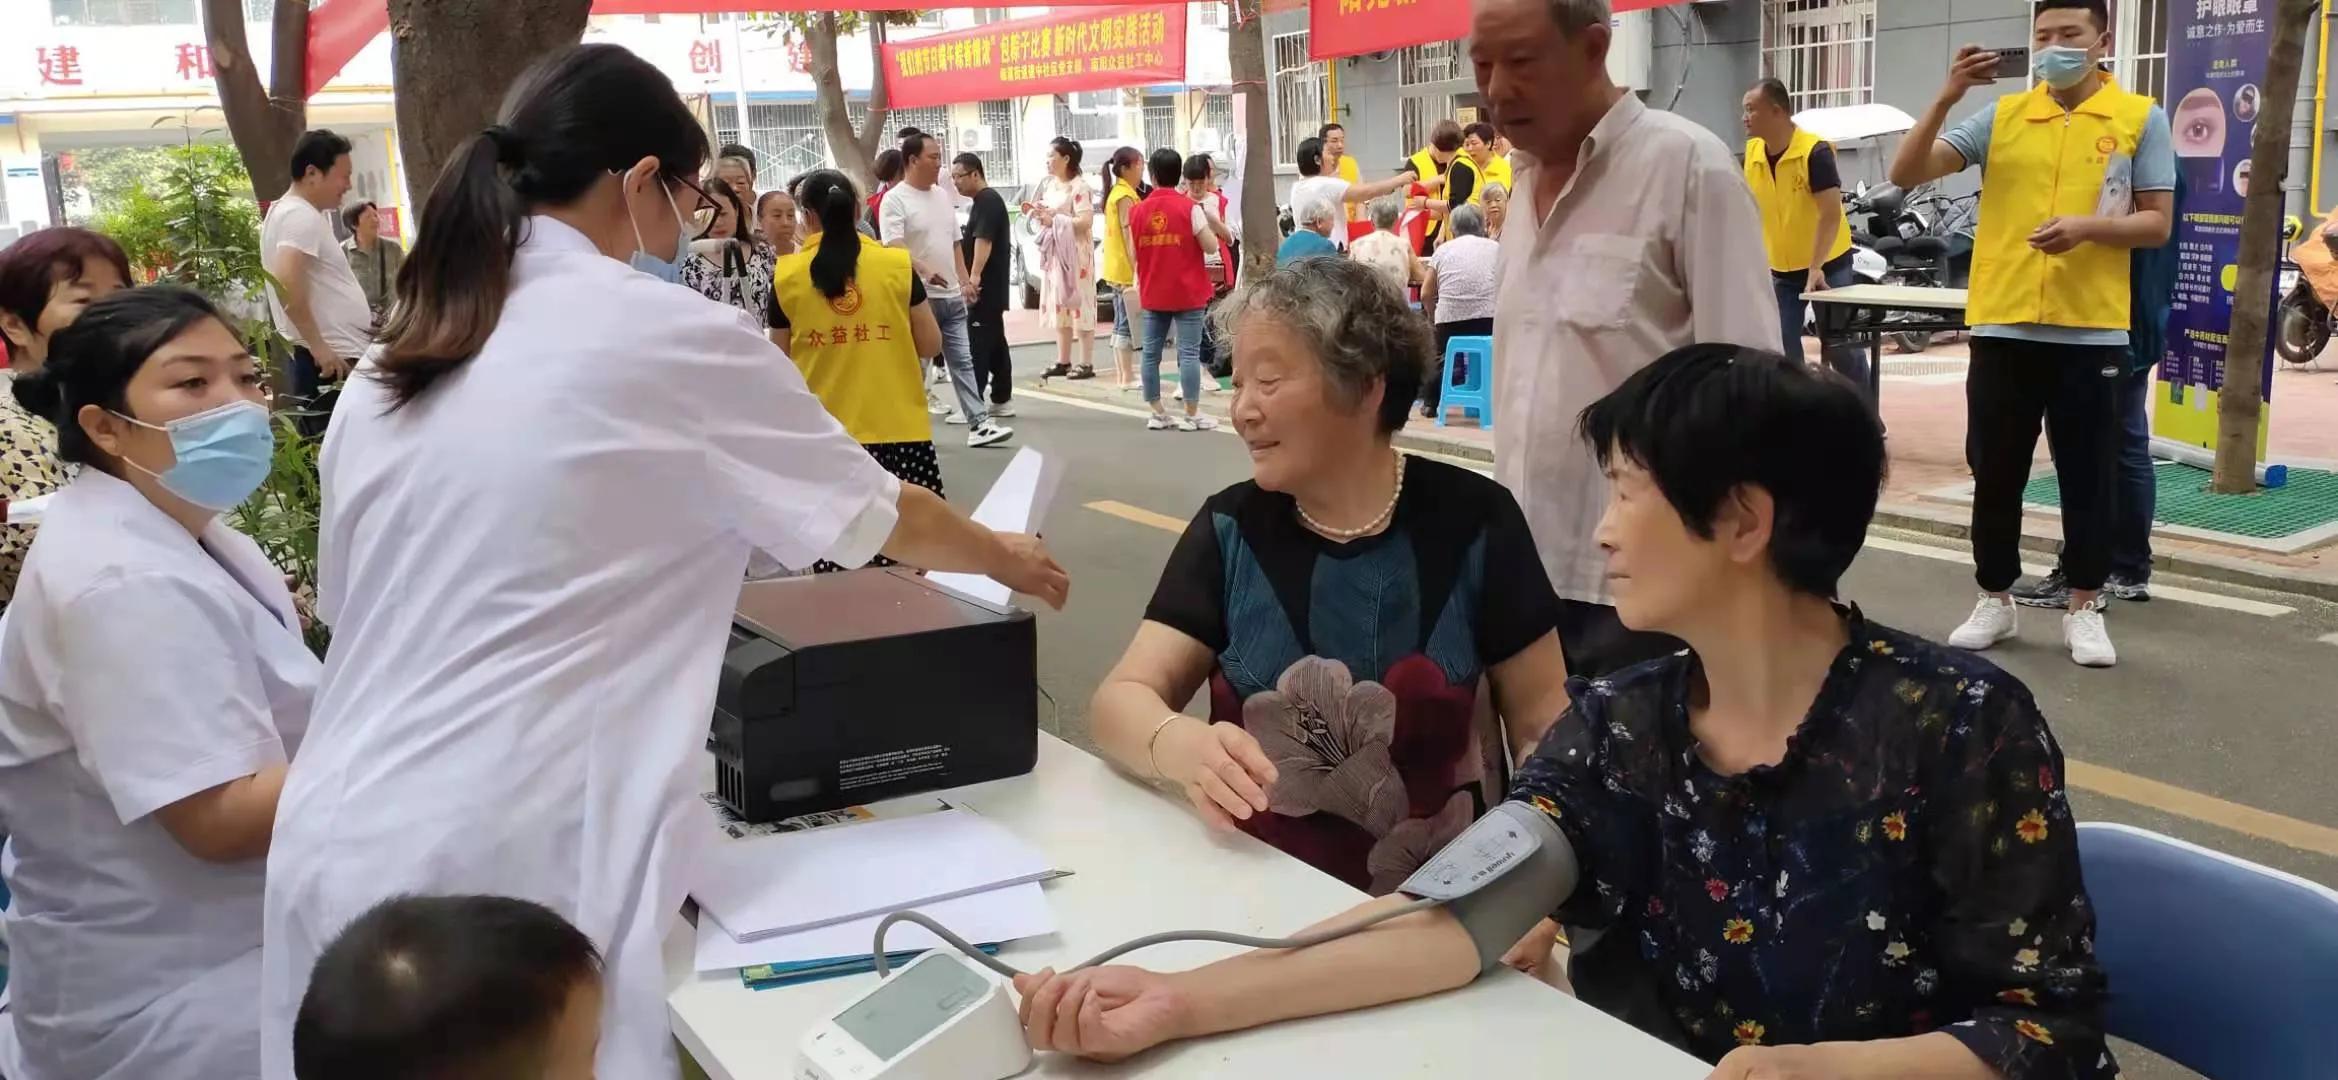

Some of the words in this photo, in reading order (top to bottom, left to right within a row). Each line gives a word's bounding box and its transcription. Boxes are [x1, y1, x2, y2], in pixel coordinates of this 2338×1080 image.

[1001, 27, 1051, 63] 包粽子比赛
[1055, 11, 1165, 56] 新时代文明实践活动
[36, 46, 82, 85] 建
[689, 39, 722, 73] 创
[808, 324, 891, 347] 众益社工
